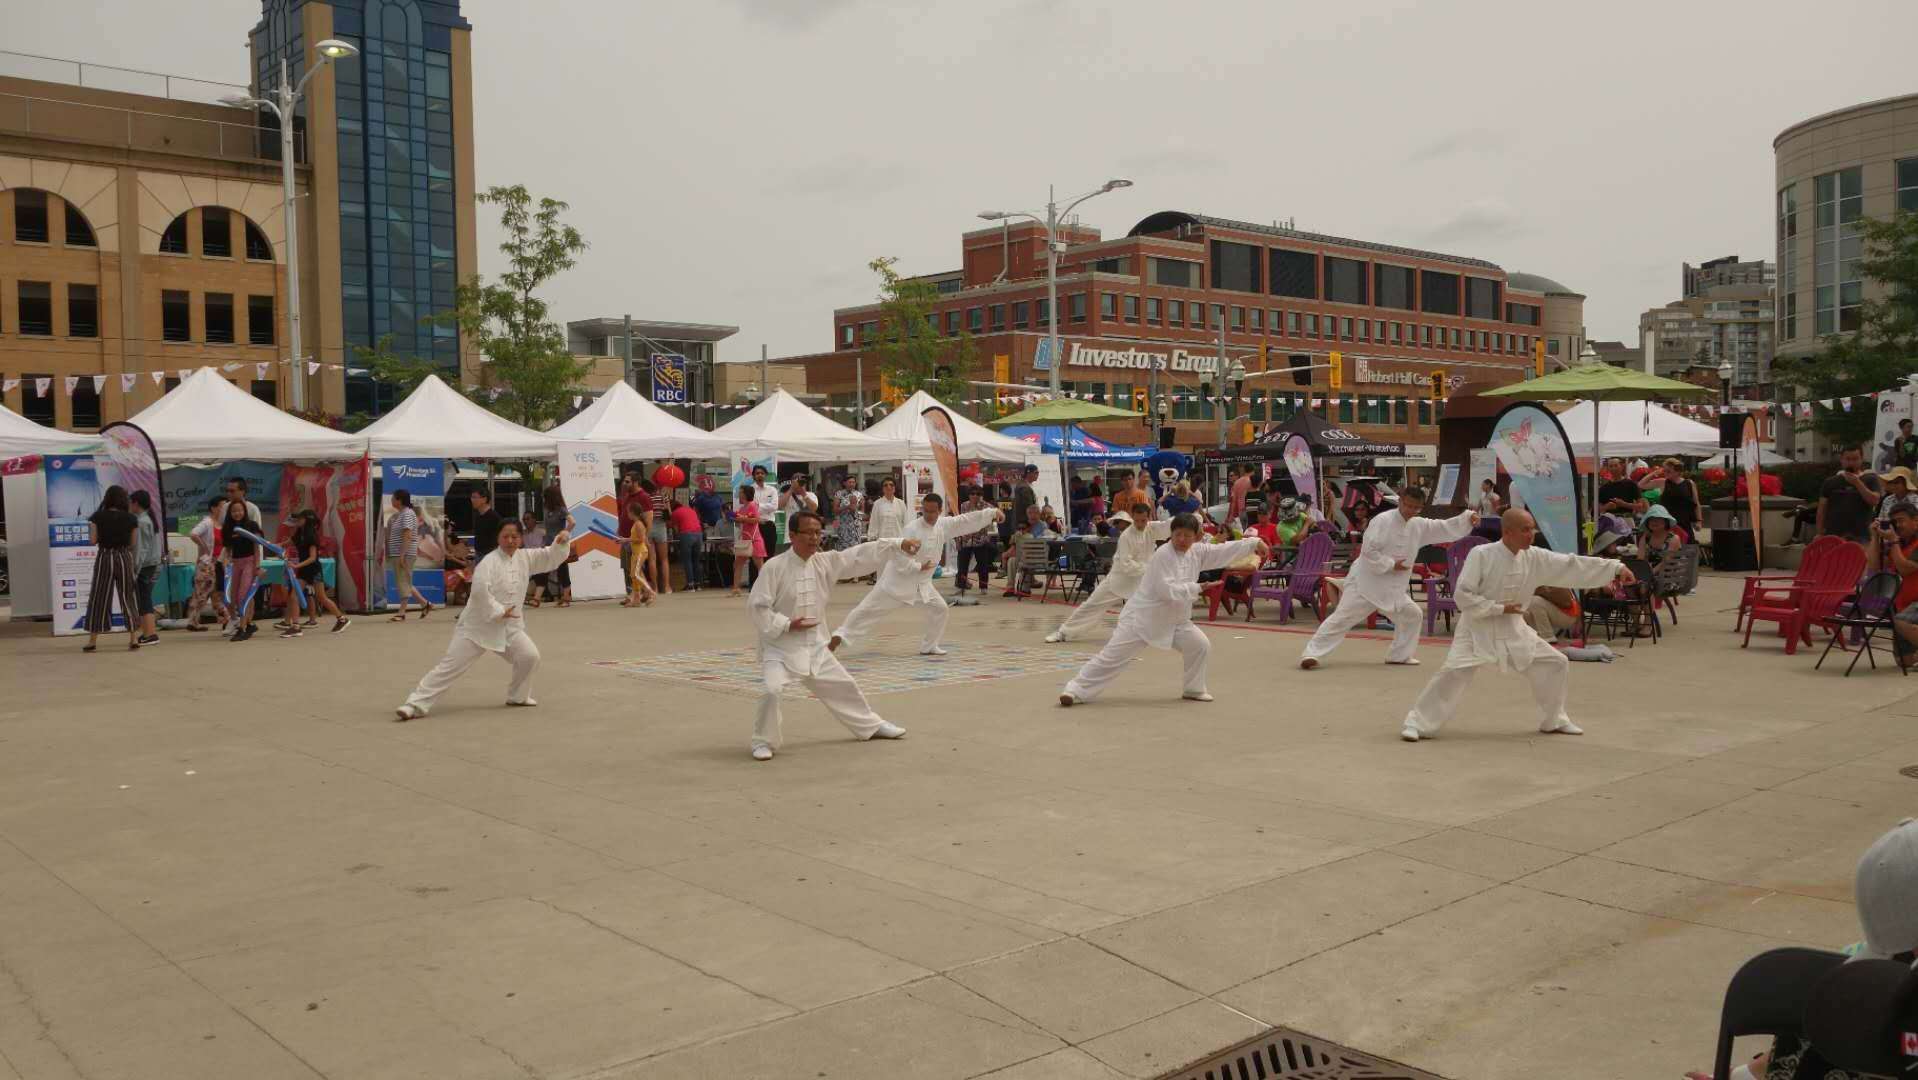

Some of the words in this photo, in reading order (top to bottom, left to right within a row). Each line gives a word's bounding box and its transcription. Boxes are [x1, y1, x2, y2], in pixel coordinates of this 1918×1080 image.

[1068, 342, 1168, 369] Investors
[1170, 349, 1230, 377] Group
[1369, 370, 1393, 384] Robert
[1394, 371, 1412, 385] Half
[656, 389, 683, 401] RBC
[574, 452, 599, 464] YES,
